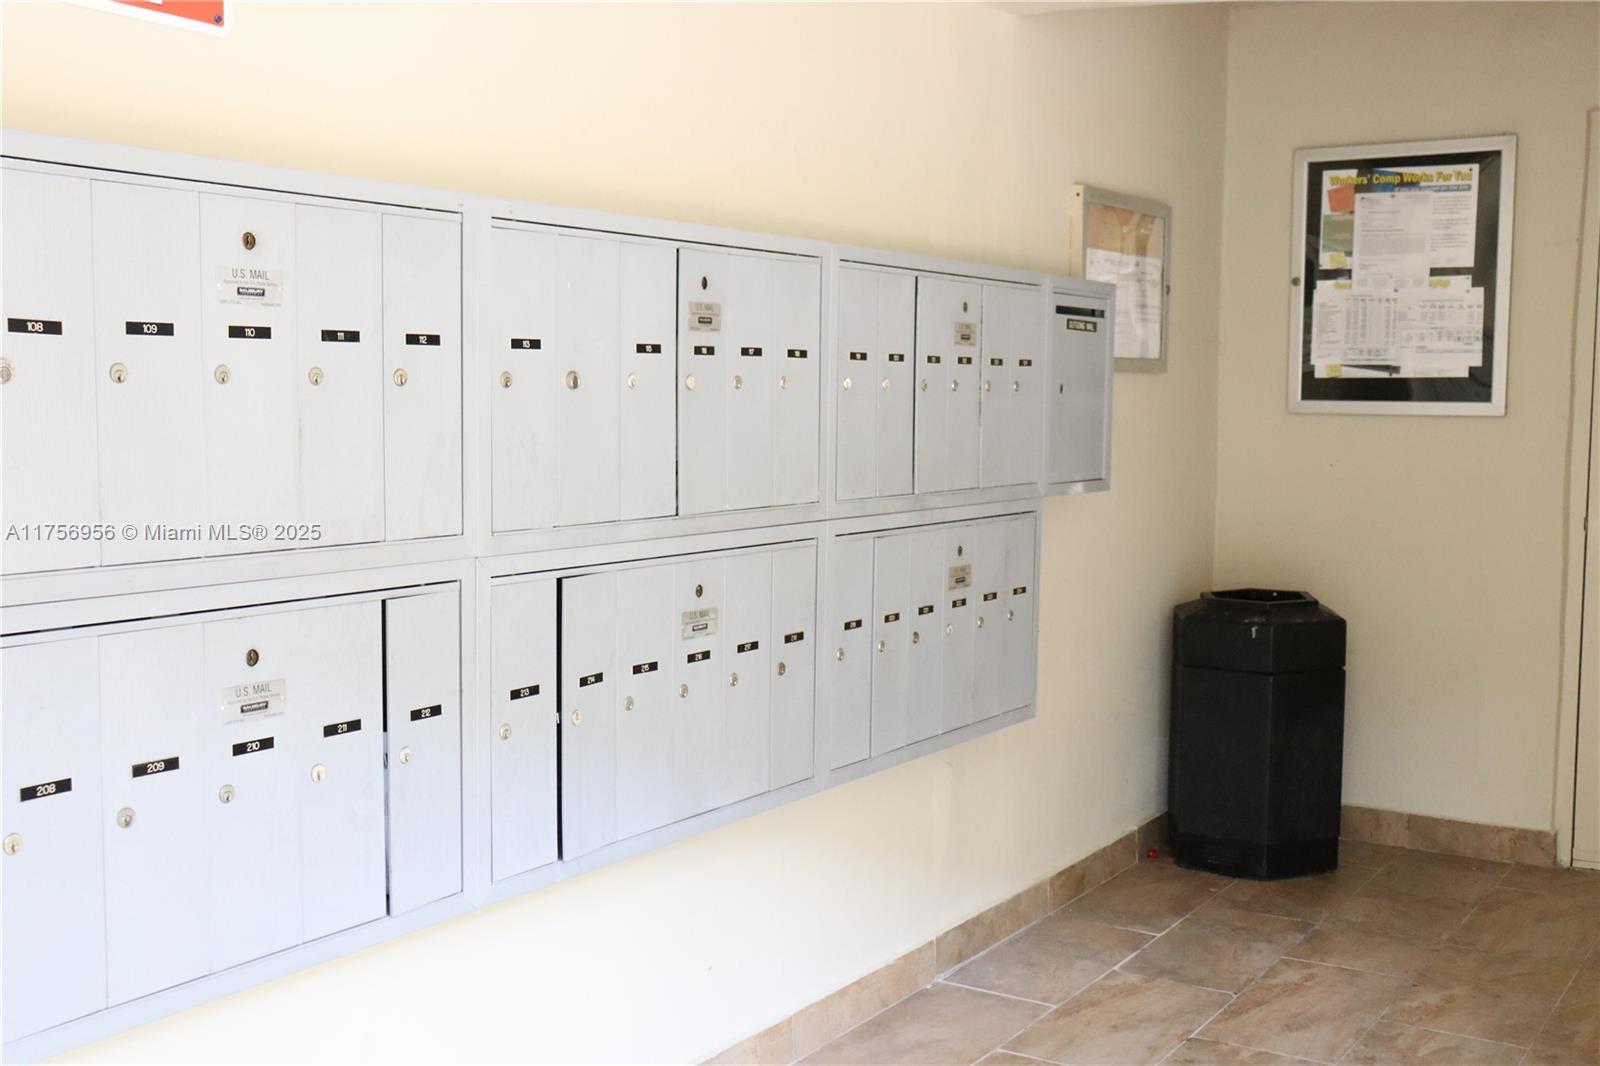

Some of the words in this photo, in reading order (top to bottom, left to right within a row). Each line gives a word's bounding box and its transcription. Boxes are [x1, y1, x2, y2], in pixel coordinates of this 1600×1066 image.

[1373, 174, 1401, 185] Comp
[1403, 172, 1434, 183] Works
[1436, 171, 1453, 182] For
[1454, 170, 1473, 182] You
[232, 268, 248, 279] U.S.
[250, 269, 270, 281] MAIL
[26, 321, 44, 332] 108
[142, 324, 158, 334] 109
[245, 328, 256, 337] 110
[337, 332, 345, 341] 111
[418, 335, 427, 344] 112
[236, 686, 250, 698] U.S.
[252, 683, 272, 695] MAIL
[520, 687, 530, 698] 213
[421, 708, 431, 718] 212
[337, 724, 348, 734] 211
[246, 741, 260, 752] 210
[146, 761, 165, 774] 209
[36, 783, 57, 797] 208
